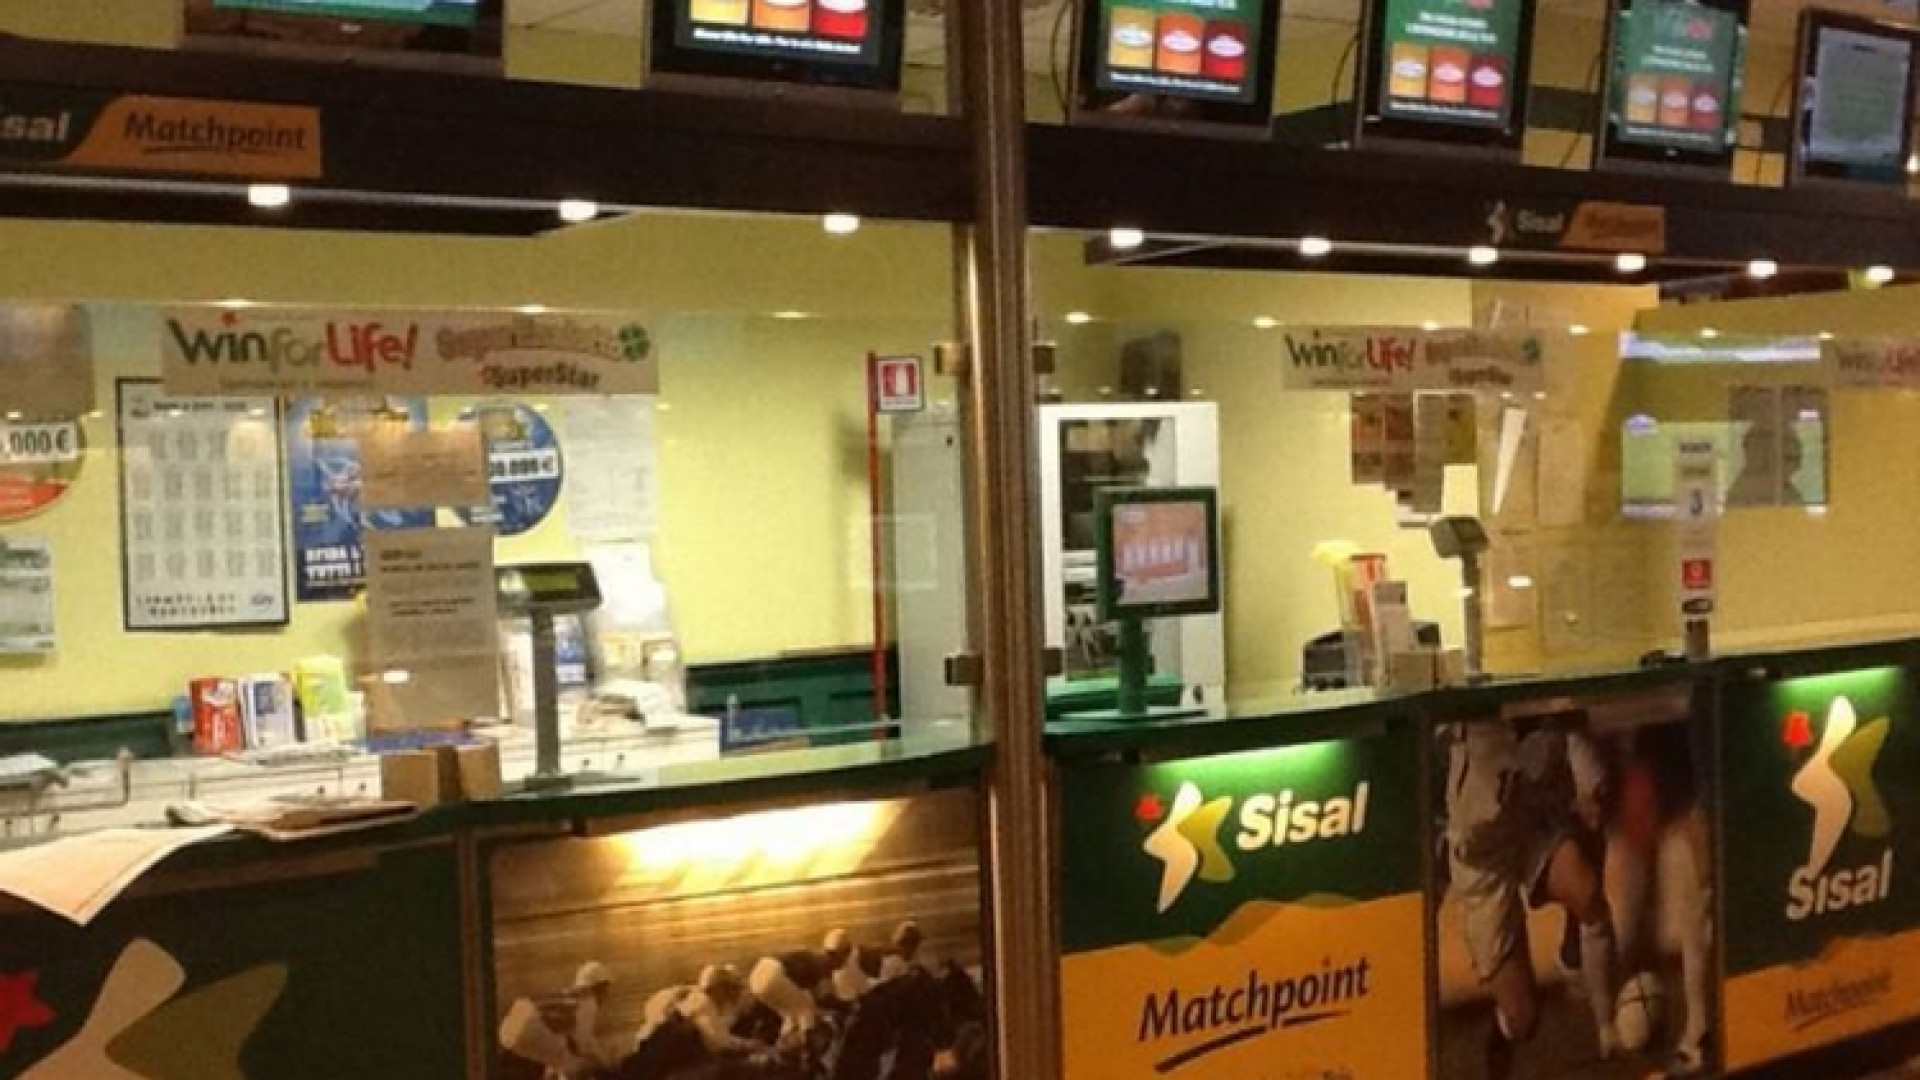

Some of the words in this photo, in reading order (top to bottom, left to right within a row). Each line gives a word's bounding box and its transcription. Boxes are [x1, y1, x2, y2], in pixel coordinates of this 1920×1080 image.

[123, 111, 305, 152] Matchpoint
[1235, 779, 1370, 851] Sisal
[1786, 848, 1893, 921] Sisal
[1137, 955, 1370, 1042] Matchpoint
